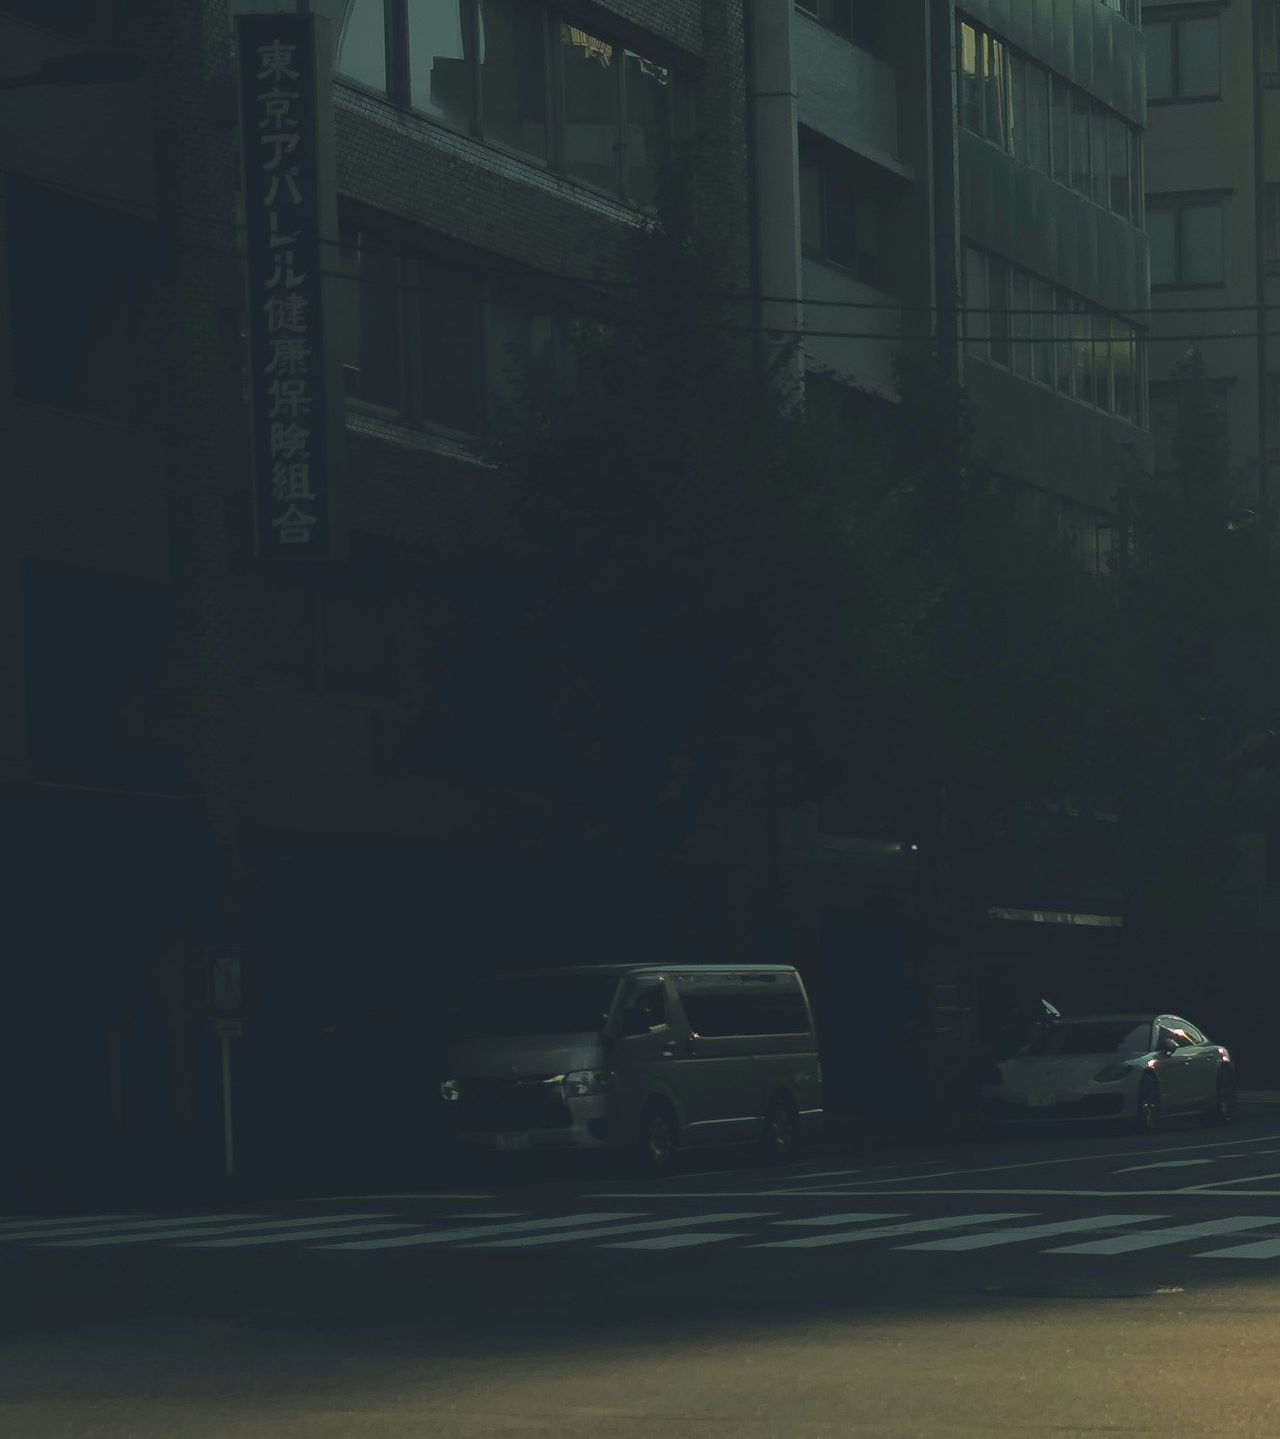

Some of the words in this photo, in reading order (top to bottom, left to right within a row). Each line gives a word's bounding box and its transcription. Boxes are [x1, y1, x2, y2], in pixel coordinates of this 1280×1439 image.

[257, 39, 317, 545] 東京アパレル健康保険組合
